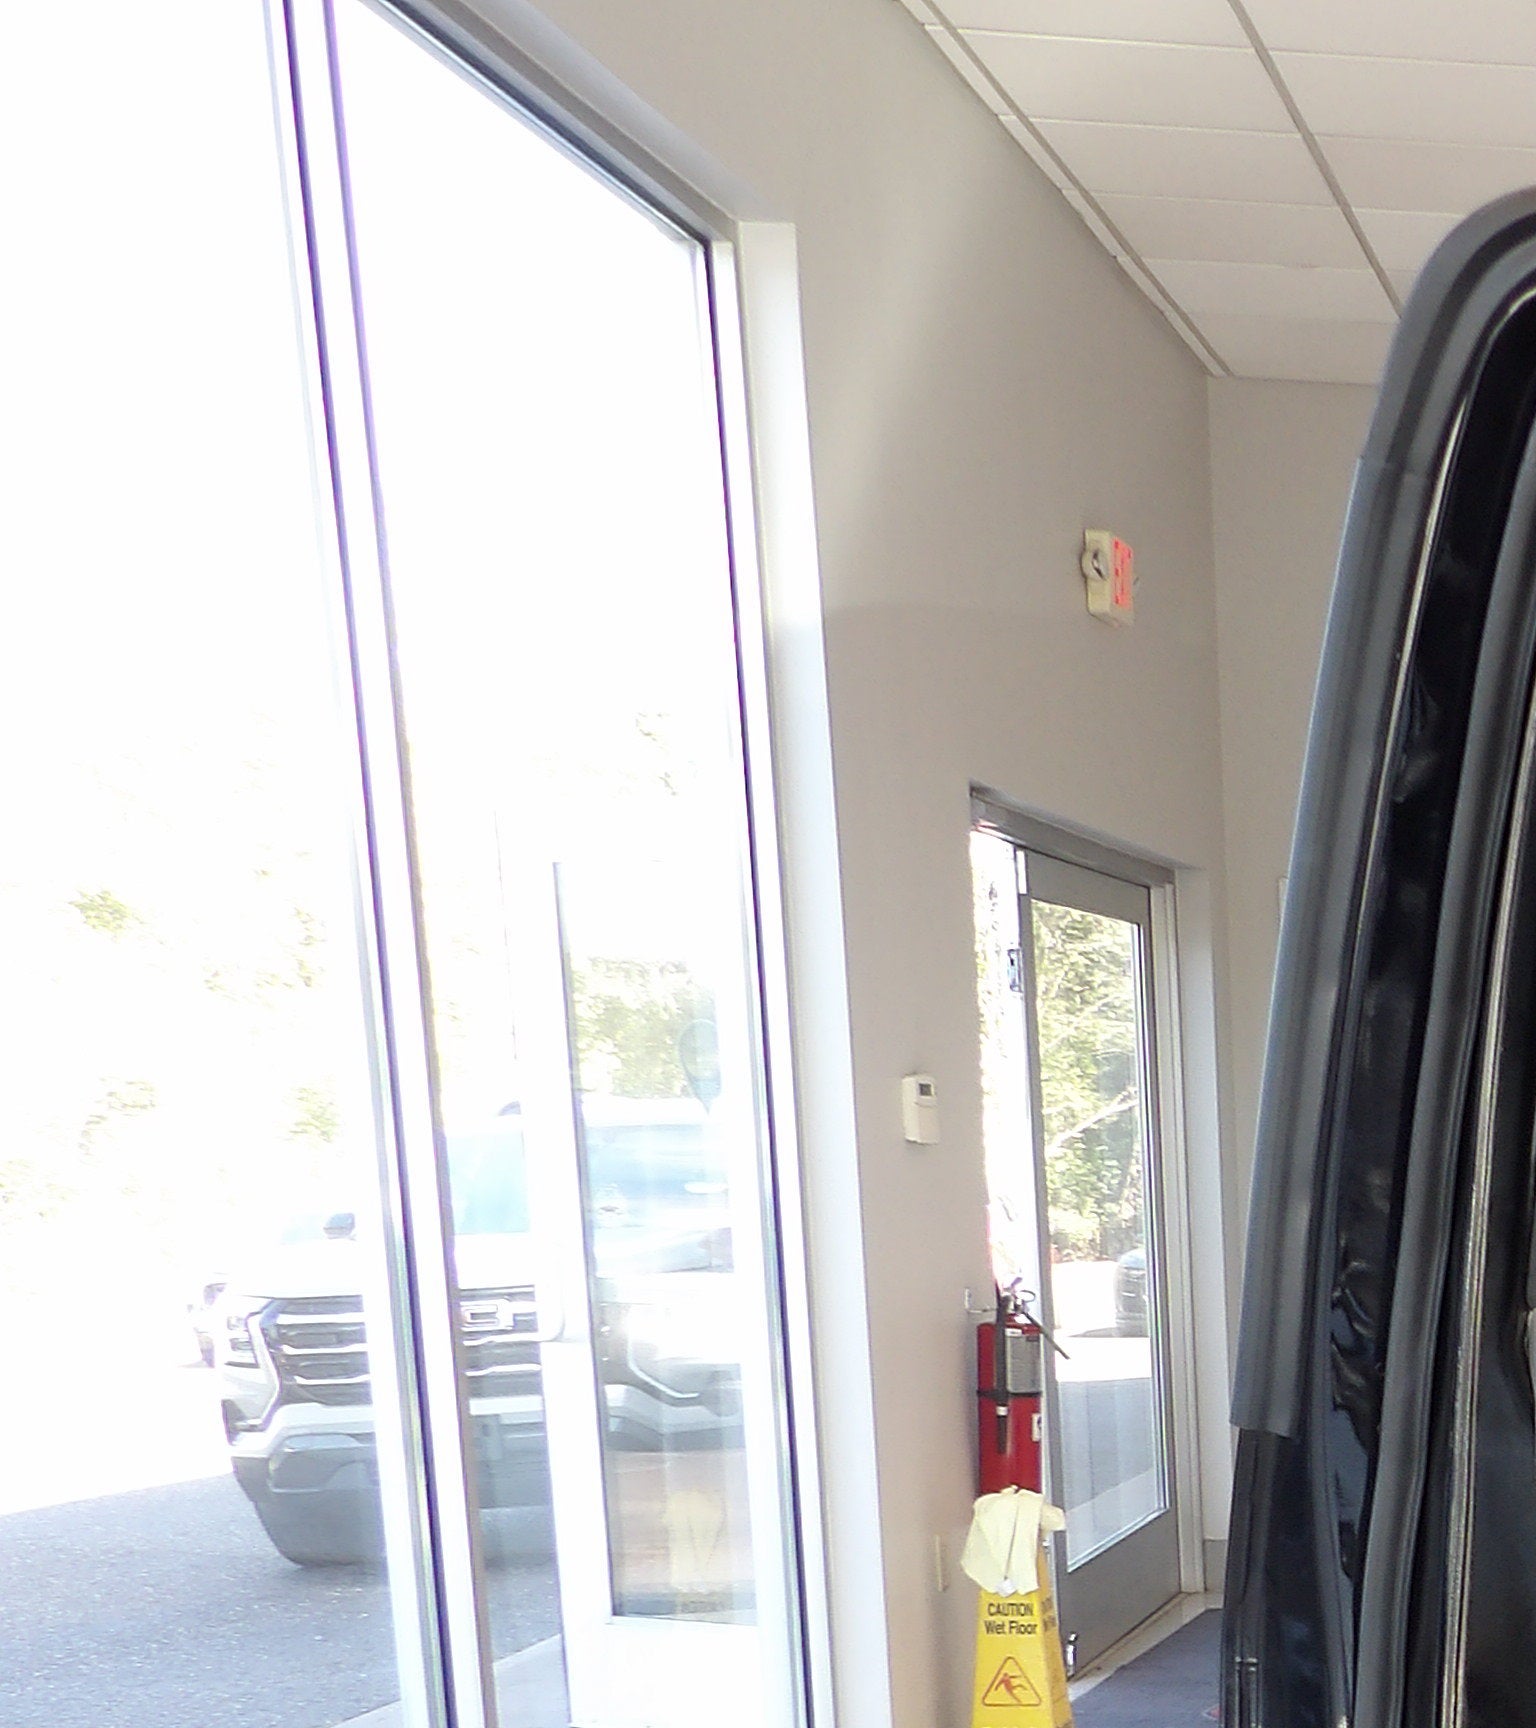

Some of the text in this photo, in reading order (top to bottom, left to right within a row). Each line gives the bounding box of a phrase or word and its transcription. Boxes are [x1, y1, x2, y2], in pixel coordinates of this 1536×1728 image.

[987, 1603, 1034, 1616] CAUTION
[984, 1620, 1038, 1634] Wet Floor
